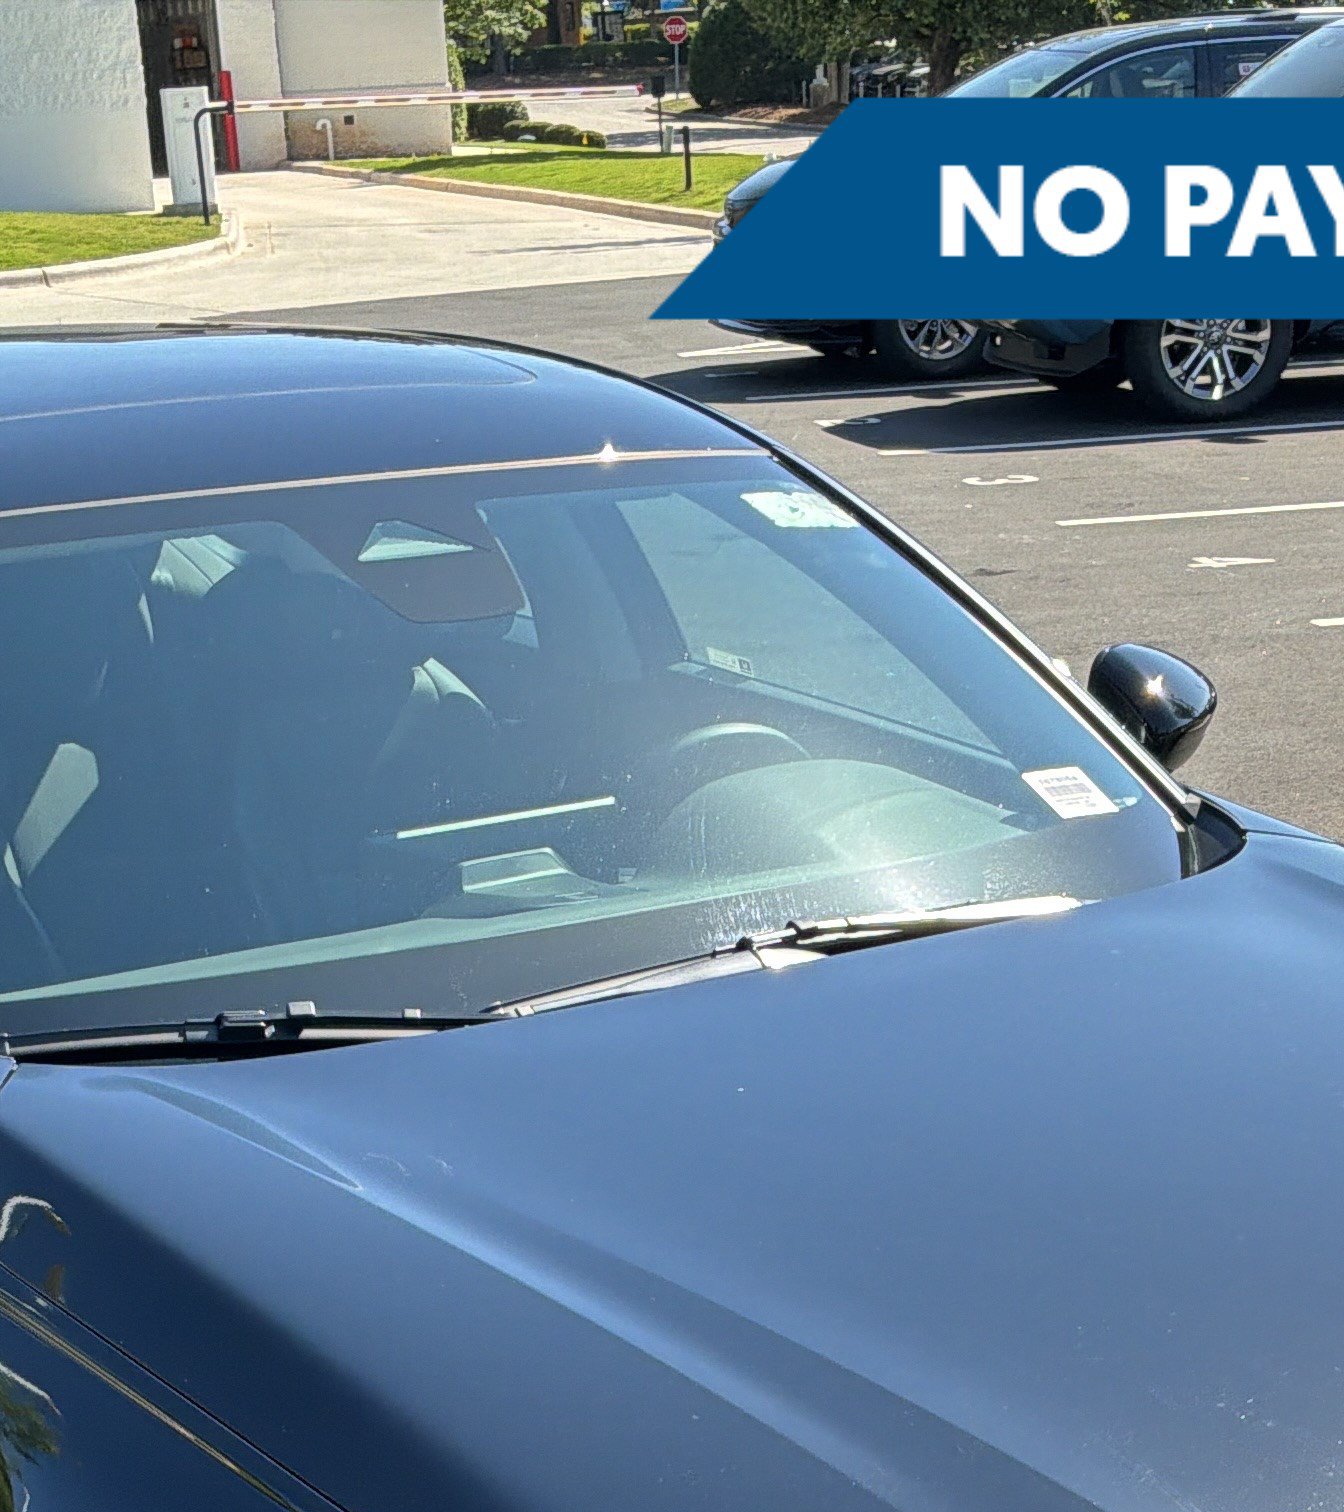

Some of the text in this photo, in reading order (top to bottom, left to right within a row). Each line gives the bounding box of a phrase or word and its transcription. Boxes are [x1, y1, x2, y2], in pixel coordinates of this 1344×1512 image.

[666, 24, 686, 36] STOP
[961, 474, 1039, 486] 3
[1188, 557, 1276, 568] 4
